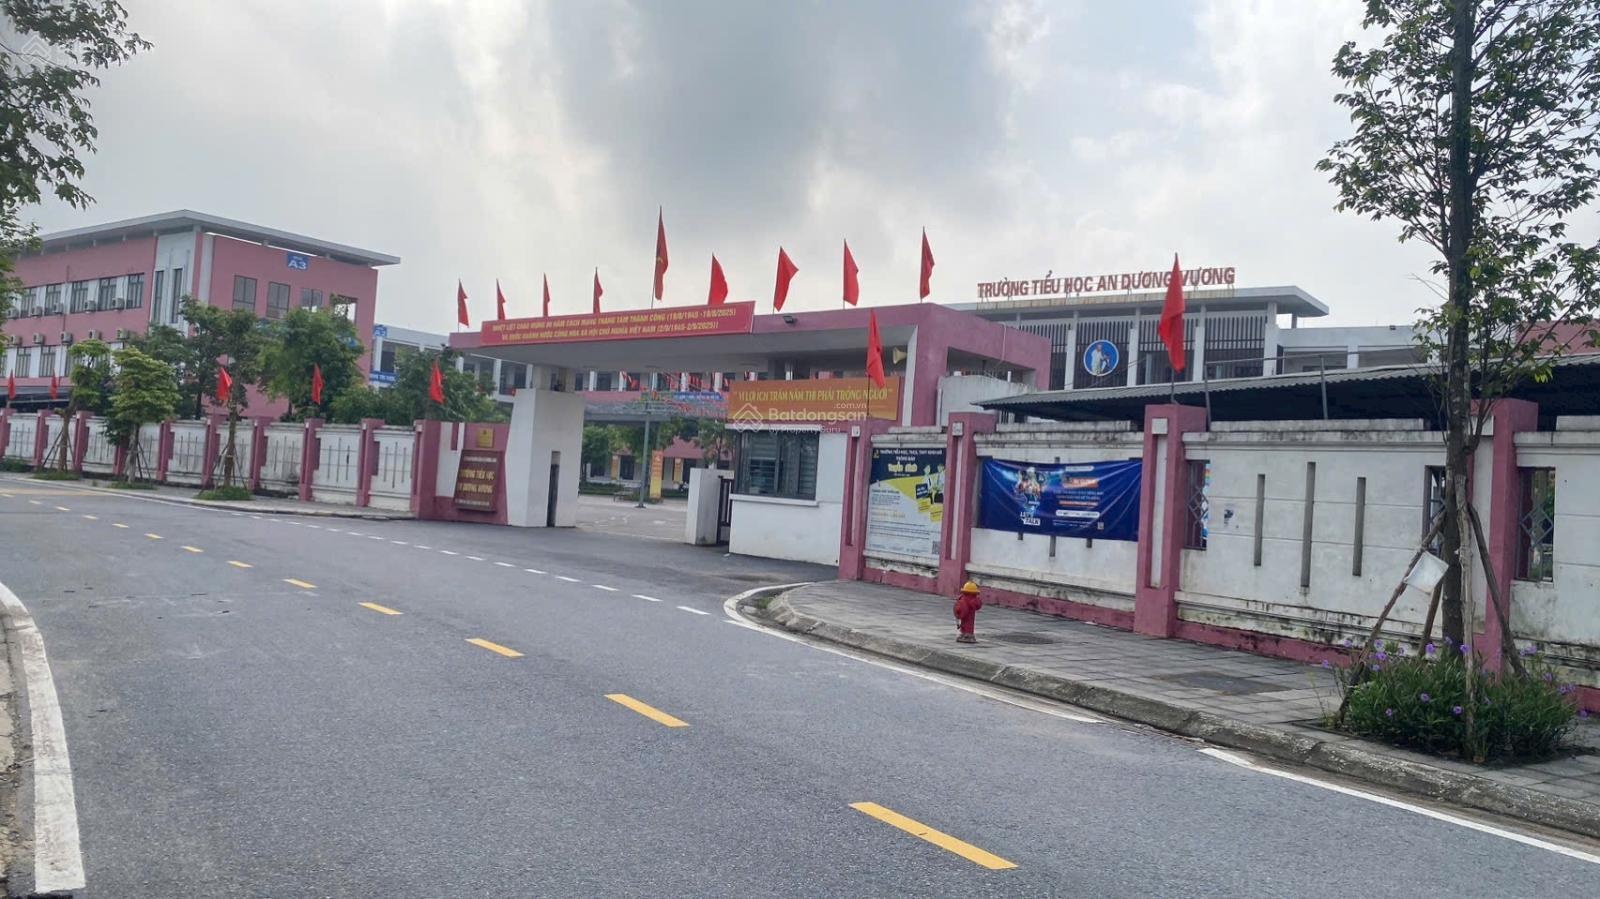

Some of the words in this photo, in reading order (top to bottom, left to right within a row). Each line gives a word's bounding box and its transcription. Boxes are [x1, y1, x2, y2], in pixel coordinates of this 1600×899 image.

[288, 260, 307, 270] A3
[978, 277, 1029, 298] TRƯỜNG
[1031, 269, 1061, 295] TIỂU
[1064, 277, 1093, 297] HỌC
[1097, 275, 1118, 291] AN
[1121, 270, 1172, 289] DƯƠNG
